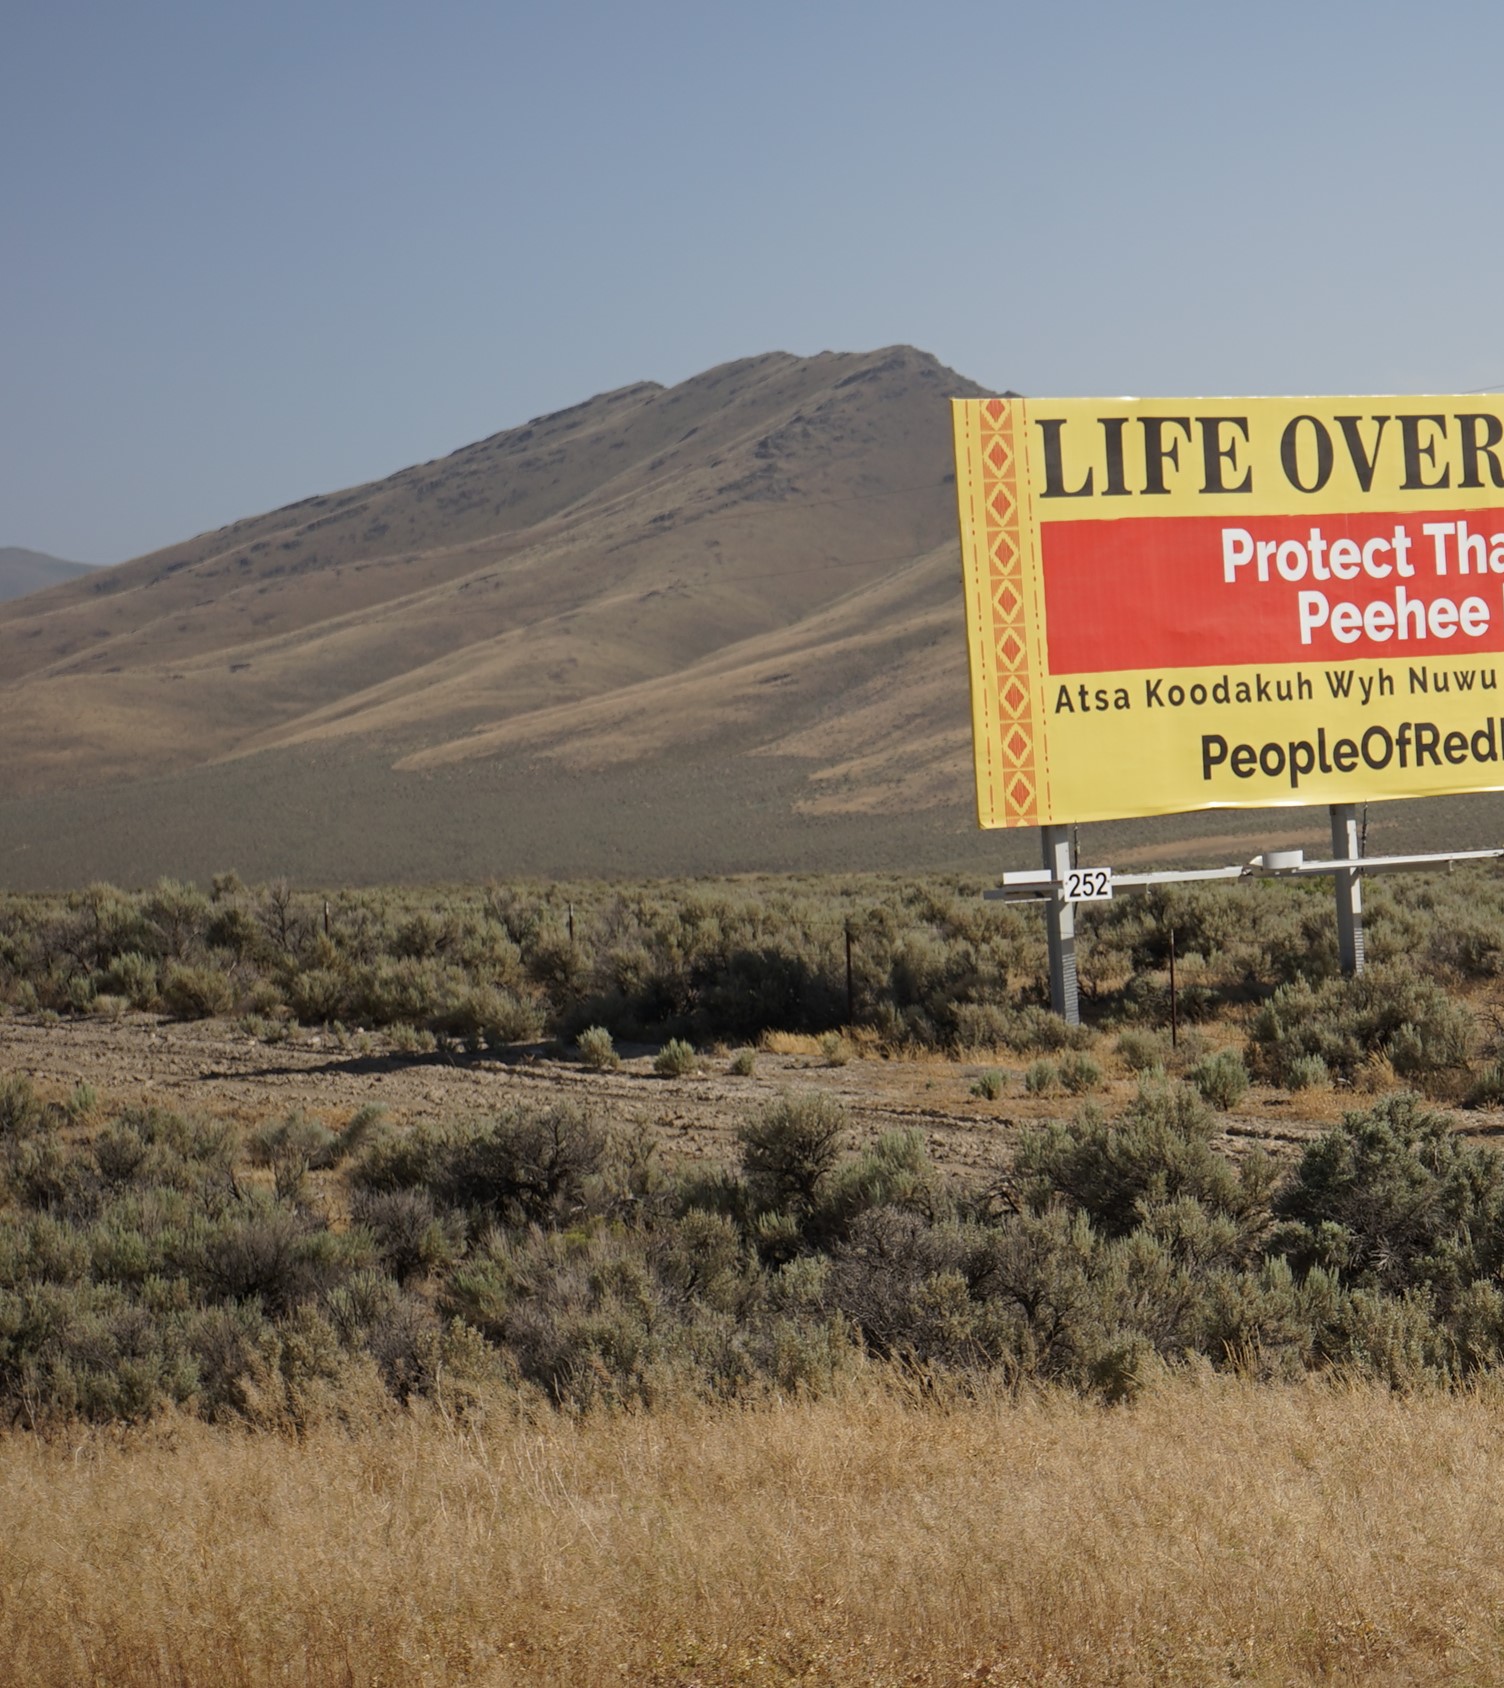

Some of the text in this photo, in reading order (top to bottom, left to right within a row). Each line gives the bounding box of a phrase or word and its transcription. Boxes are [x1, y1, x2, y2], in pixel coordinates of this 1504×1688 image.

[1034, 416, 1253, 499] LIFE
[1221, 525, 1416, 584] Protect
[1297, 585, 1490, 645] Peehee
[1054, 684, 1131, 714] Atsa
[1145, 671, 1313, 708] Koodakuh
[1324, 667, 1394, 706] Wyh
[1408, 666, 1497, 694] Nuwu
[1068, 871, 1108, 898] 252
